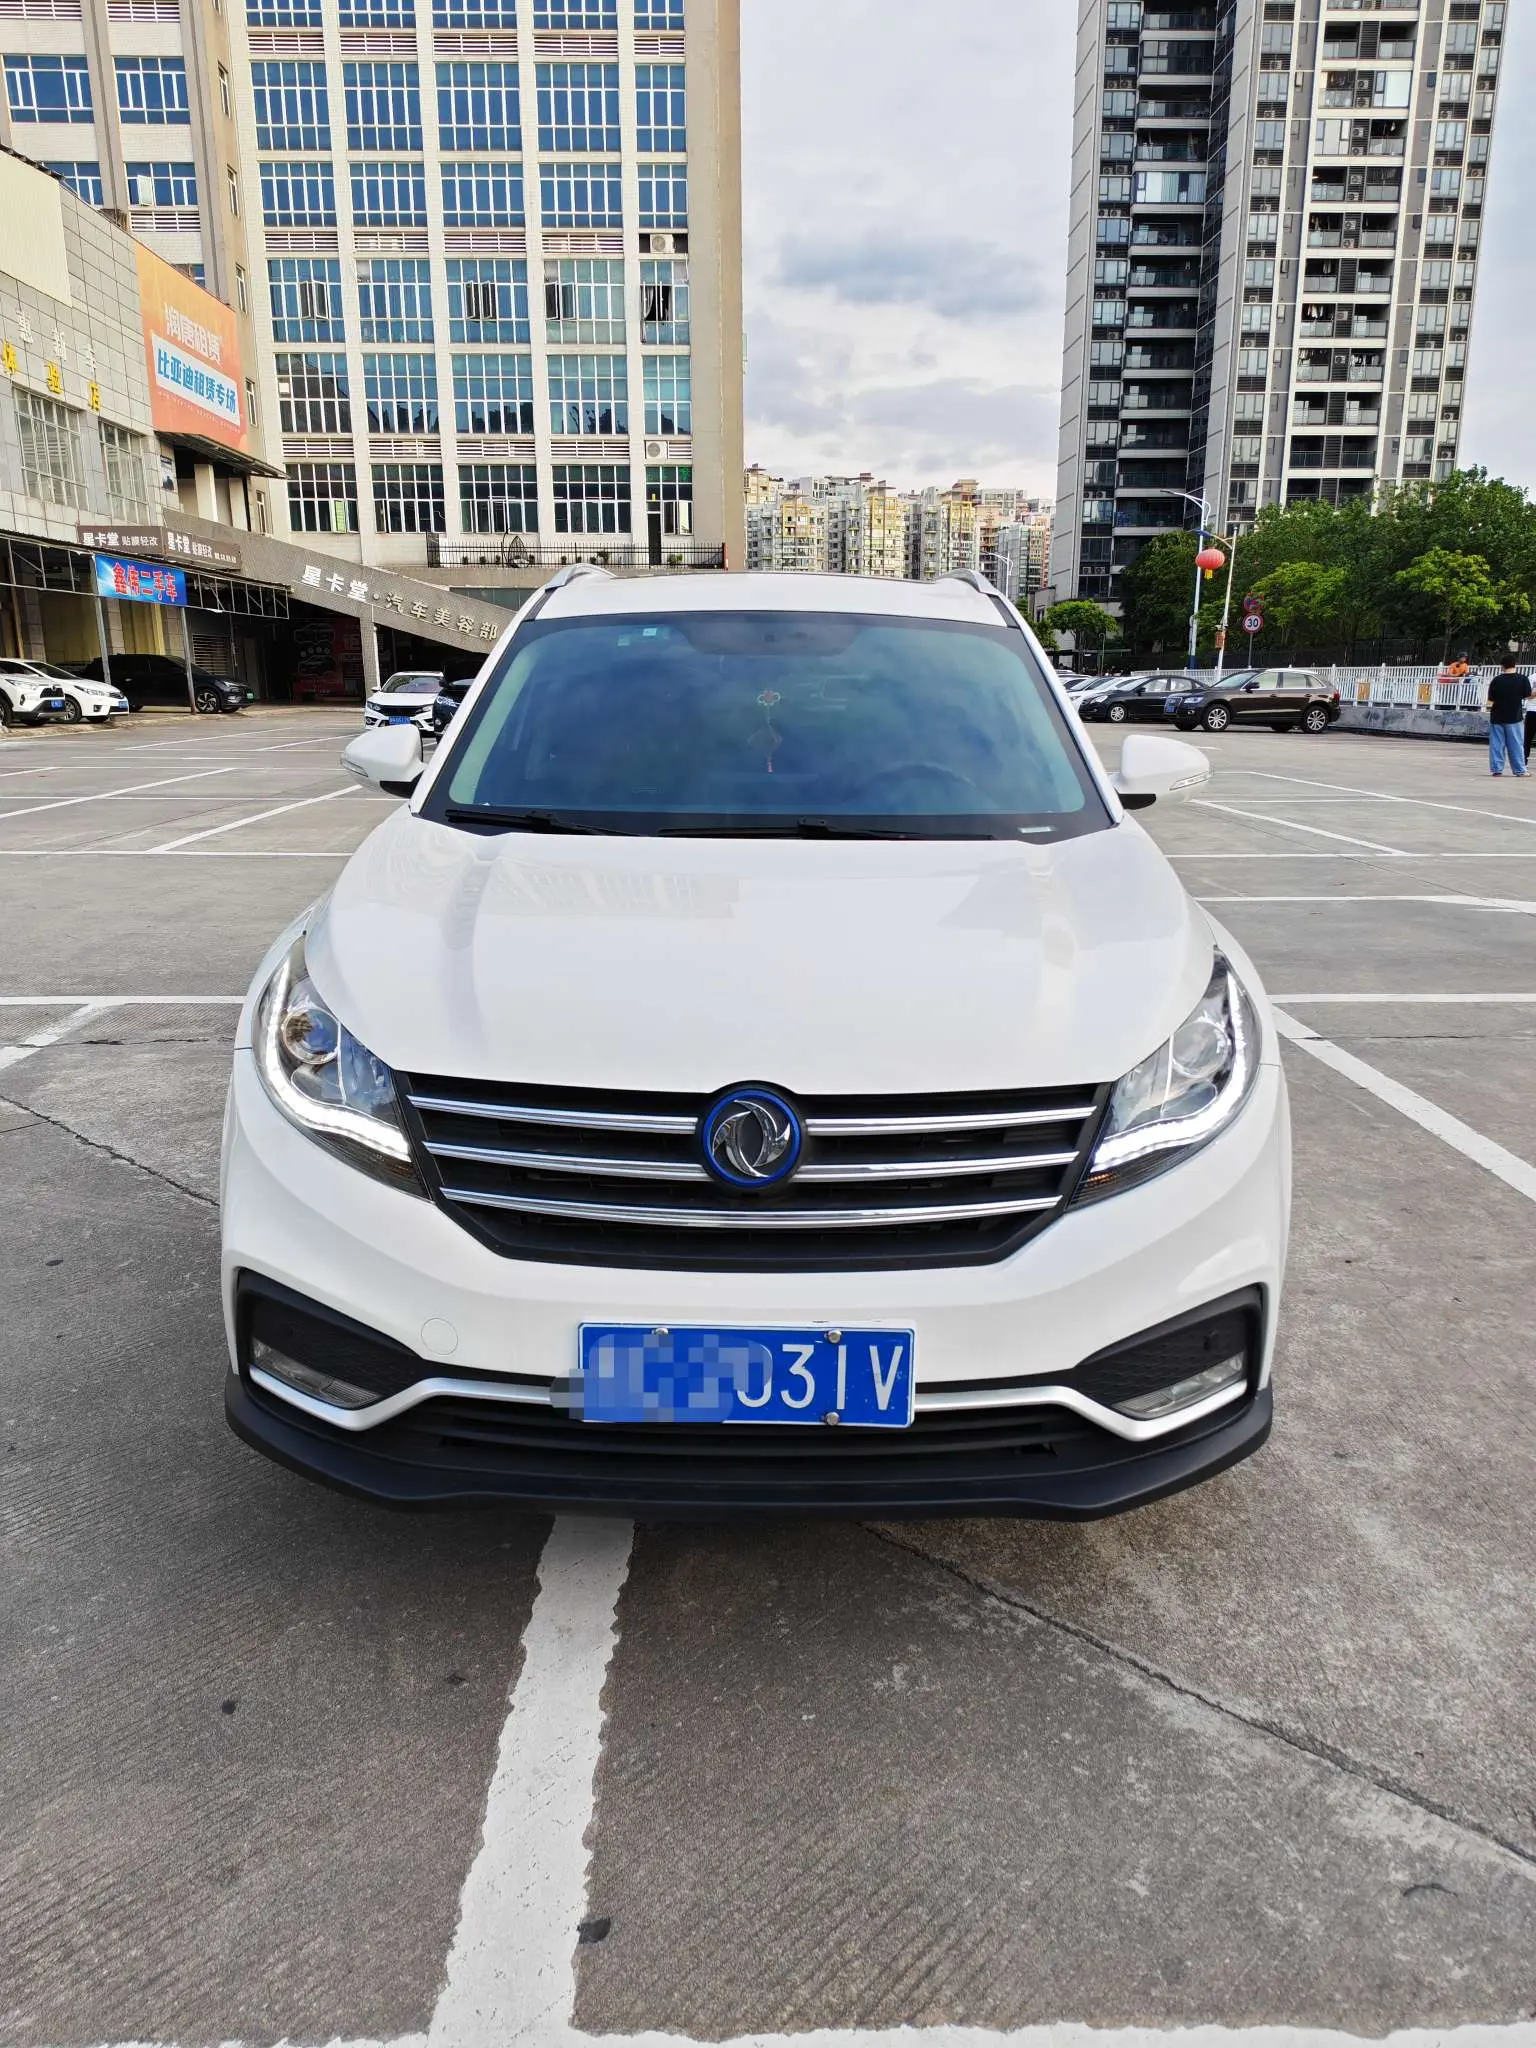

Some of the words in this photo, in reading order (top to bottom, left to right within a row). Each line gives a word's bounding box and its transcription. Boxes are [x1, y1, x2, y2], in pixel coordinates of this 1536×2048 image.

[158, 348, 236, 414] 比亚迪租赁专场
[82, 532, 119, 546] 星卡堂
[167, 532, 191, 554] 星卡堂
[1247, 618, 1259, 628] 30
